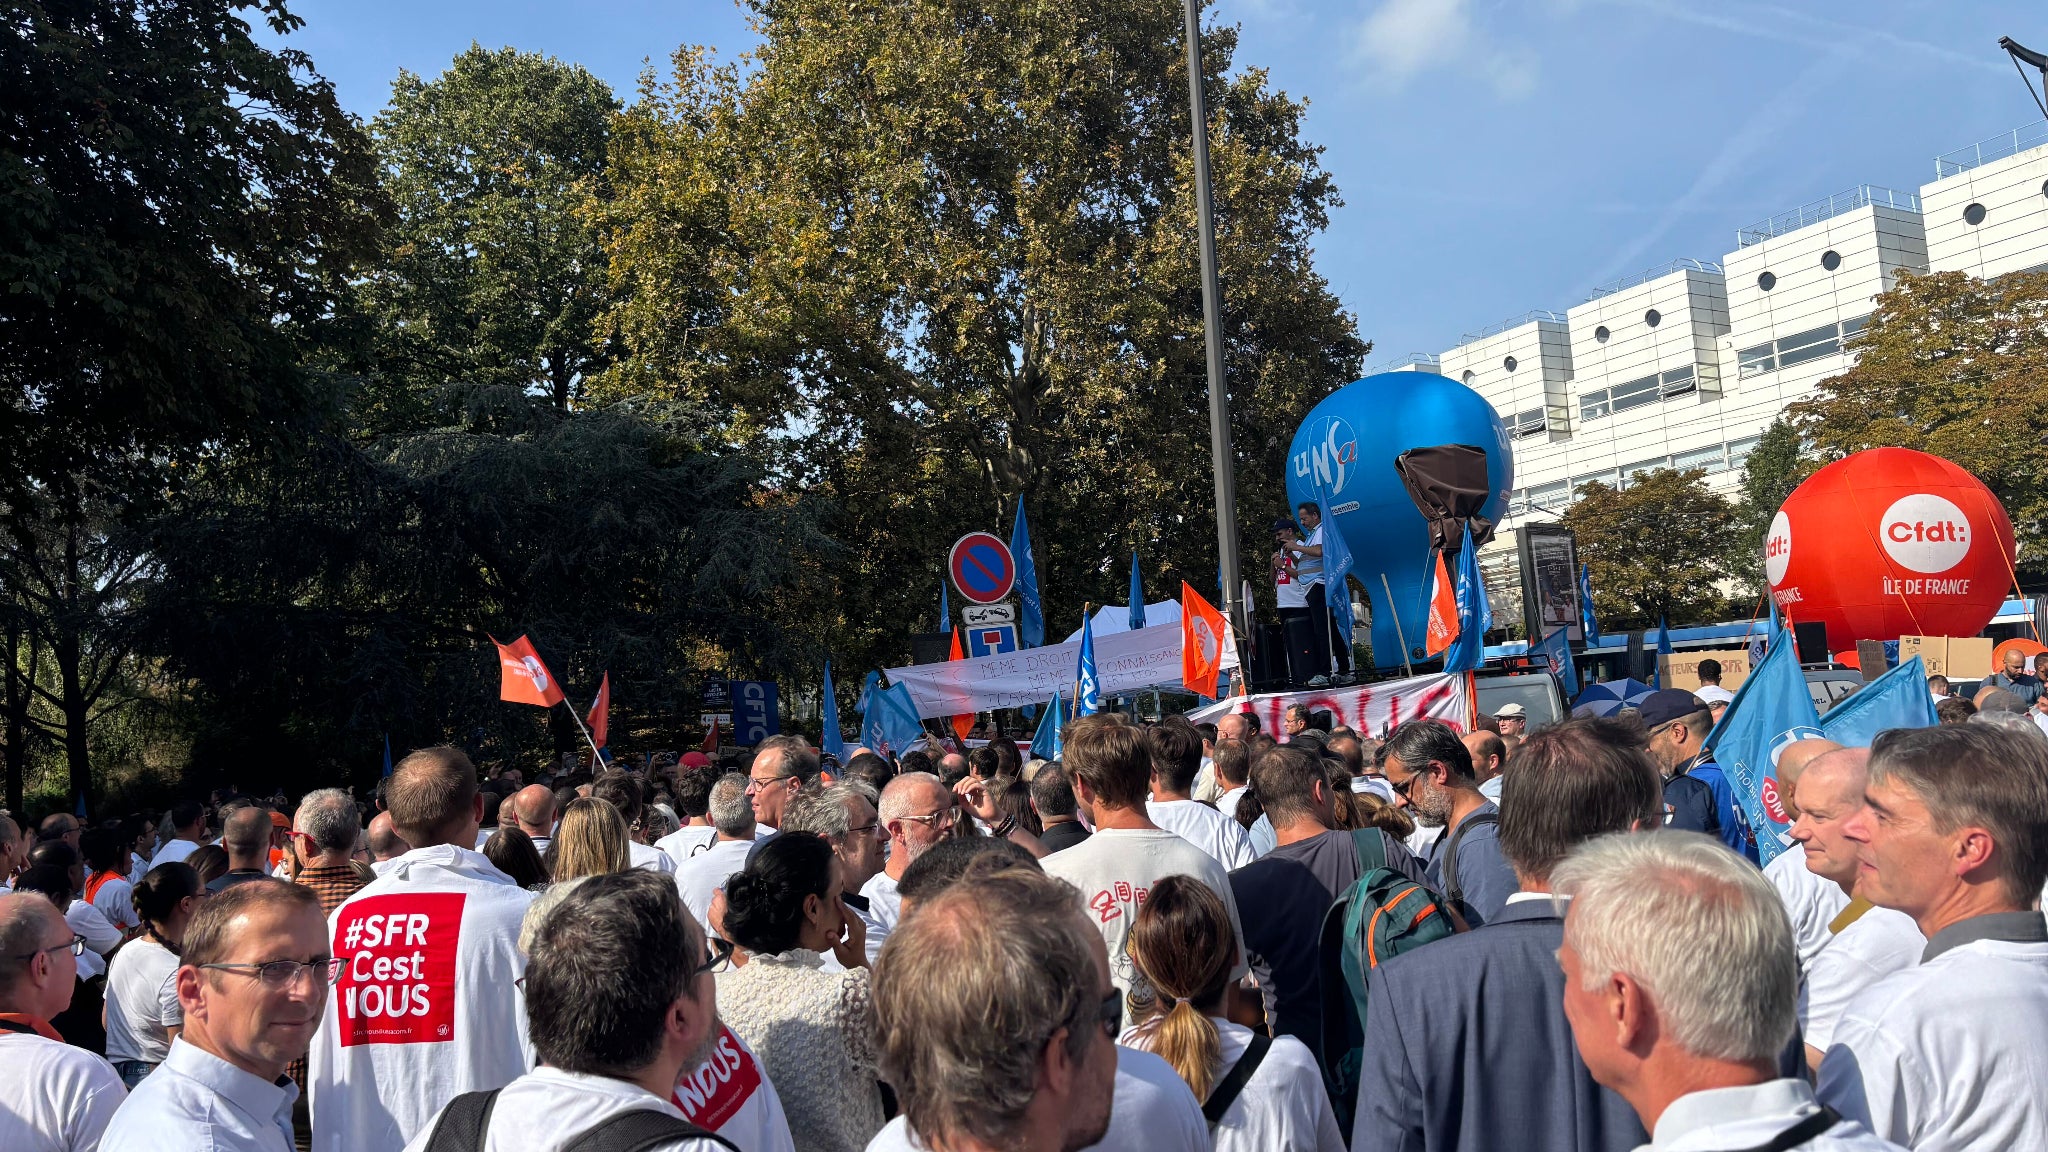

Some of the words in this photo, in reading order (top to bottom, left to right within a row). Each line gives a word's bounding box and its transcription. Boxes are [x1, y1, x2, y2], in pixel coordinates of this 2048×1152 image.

[1883, 576, 1902, 595] ÎLE
[1906, 580, 1922, 595] DE
[1926, 579, 1970, 595] FRANCE
[980, 658, 1018, 679] MEME
[1026, 651, 1073, 672] DROIT
[1098, 648, 1182, 675] CONNAISSANC
[1722, 660, 1742, 673] SFR
[344, 913, 430, 949] #SFR
[353, 950, 425, 981] Cest
[674, 1035, 741, 1118] NOUS
